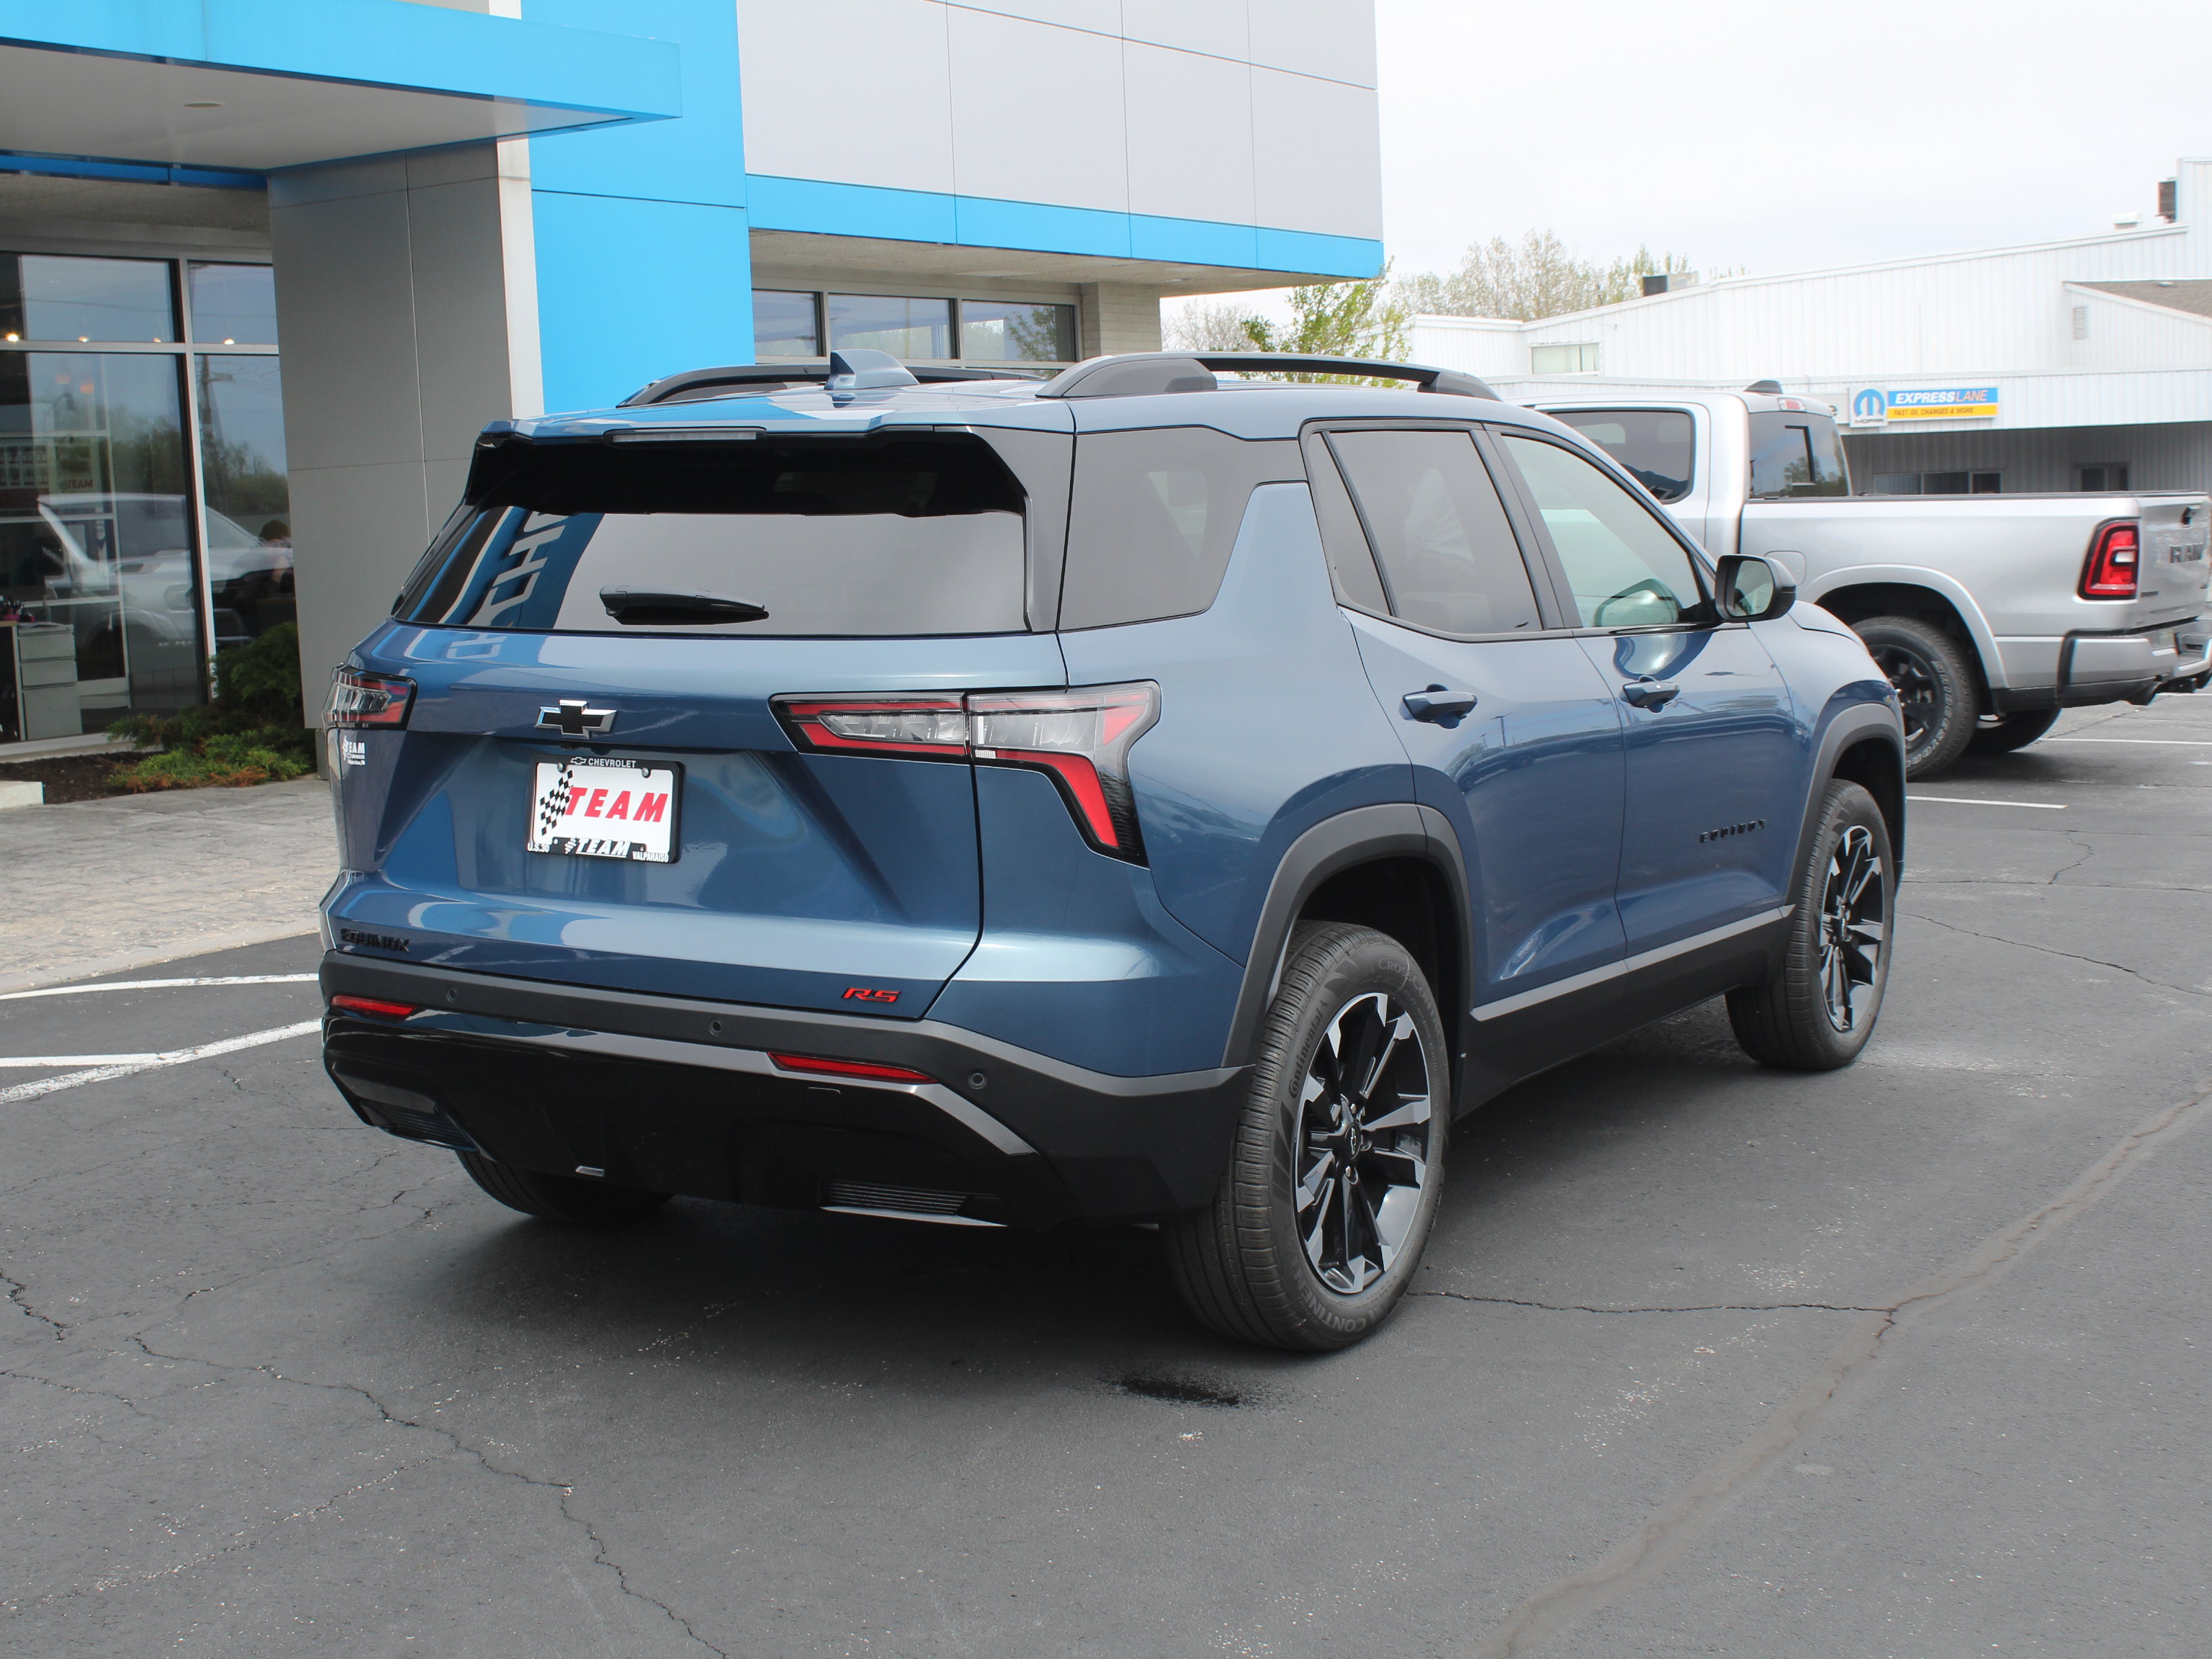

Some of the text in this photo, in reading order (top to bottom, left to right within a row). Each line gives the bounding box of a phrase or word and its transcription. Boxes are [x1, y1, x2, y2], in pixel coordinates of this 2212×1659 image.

[588, 757, 637, 768] CHEVROLET
[565, 786, 669, 823] TEAM
[576, 837, 631, 857] TEAM
[632, 850, 670, 863] VALPARAISO
[841, 987, 902, 1003] RS
